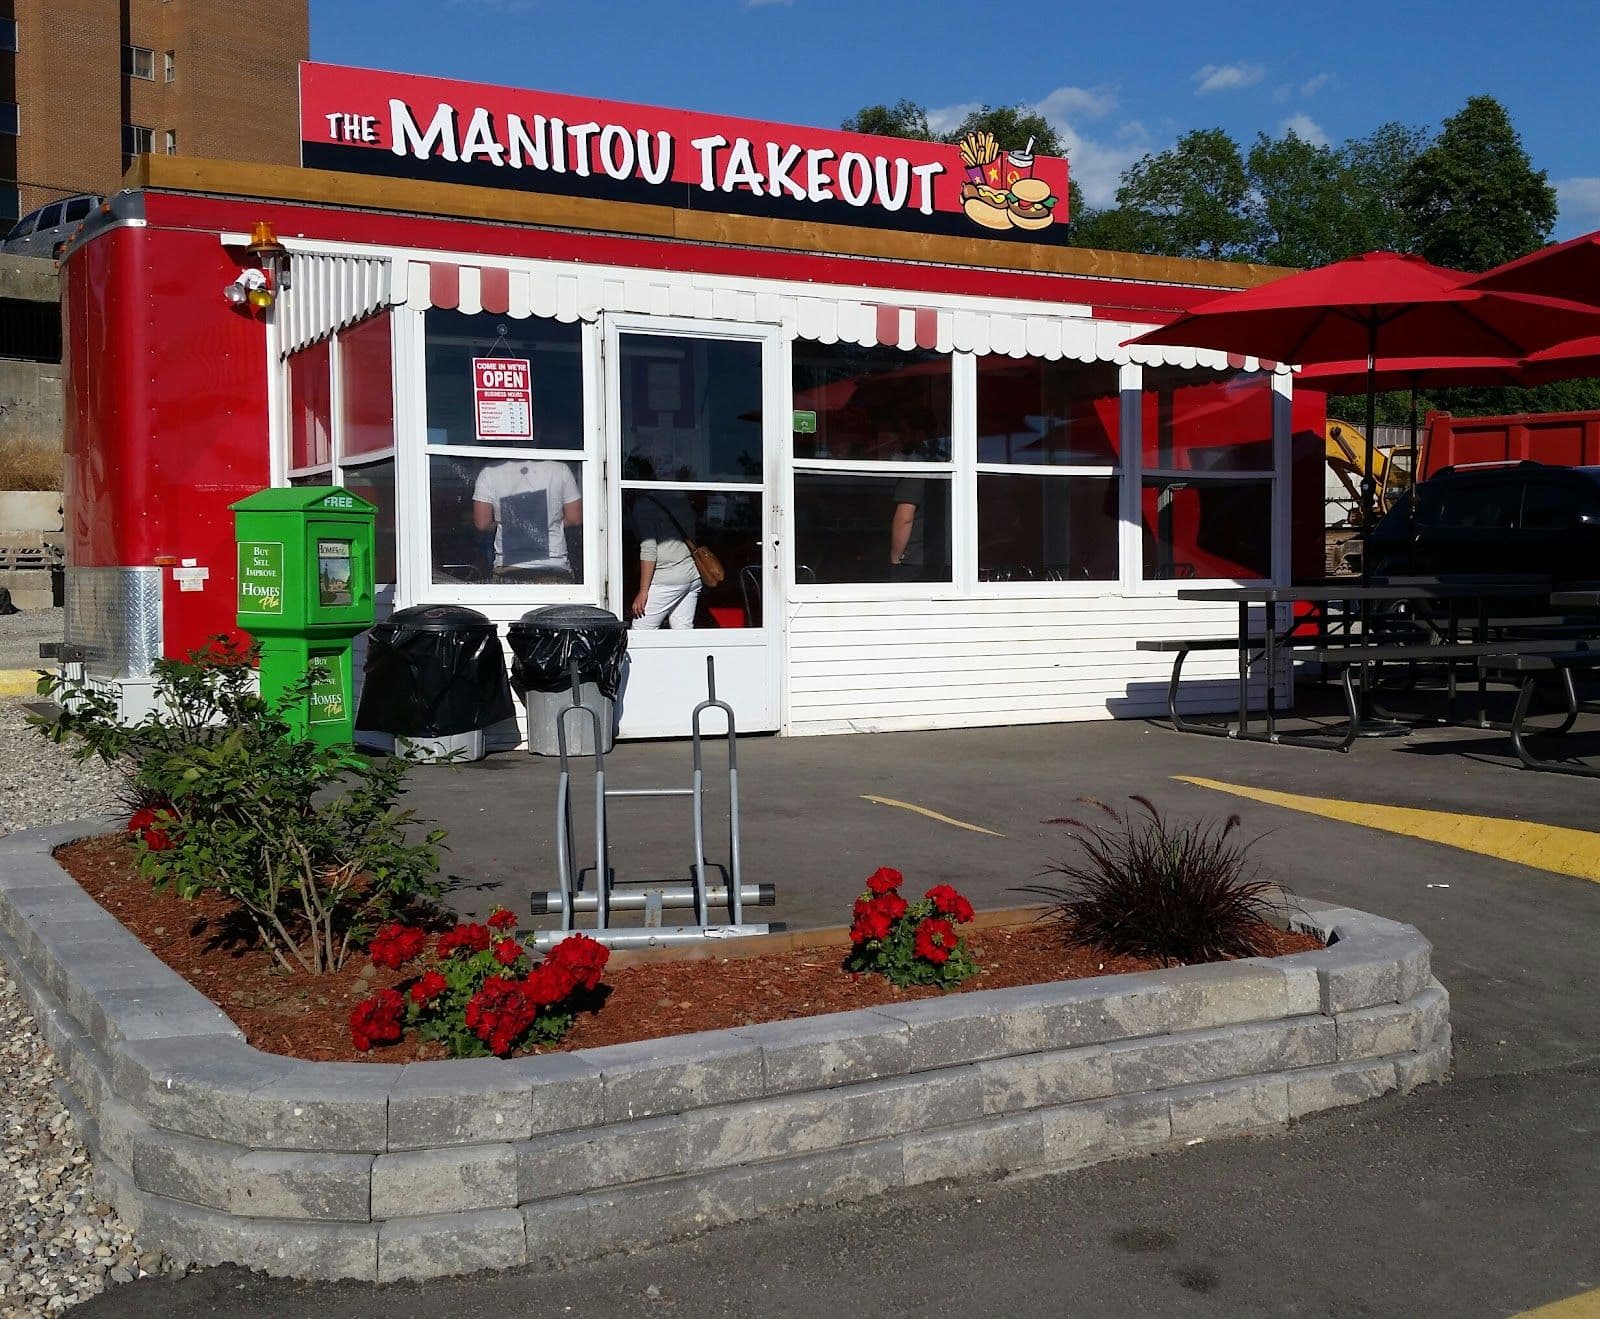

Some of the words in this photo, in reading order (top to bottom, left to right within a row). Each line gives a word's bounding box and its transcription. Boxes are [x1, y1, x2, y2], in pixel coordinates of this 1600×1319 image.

[325, 112, 378, 142] THE
[388, 98, 672, 185] MANITOU
[690, 135, 944, 215] TAKEOUT
[482, 370, 524, 388] OPEN
[323, 496, 353, 508] FREE
[253, 546, 270, 556] BUY
[253, 557, 270, 567] SELL
[246, 567, 278, 577] IMPROVE
[241, 582, 280, 596] HOMES
[314, 656, 328, 665] BUY
[310, 692, 342, 705] HOMES
